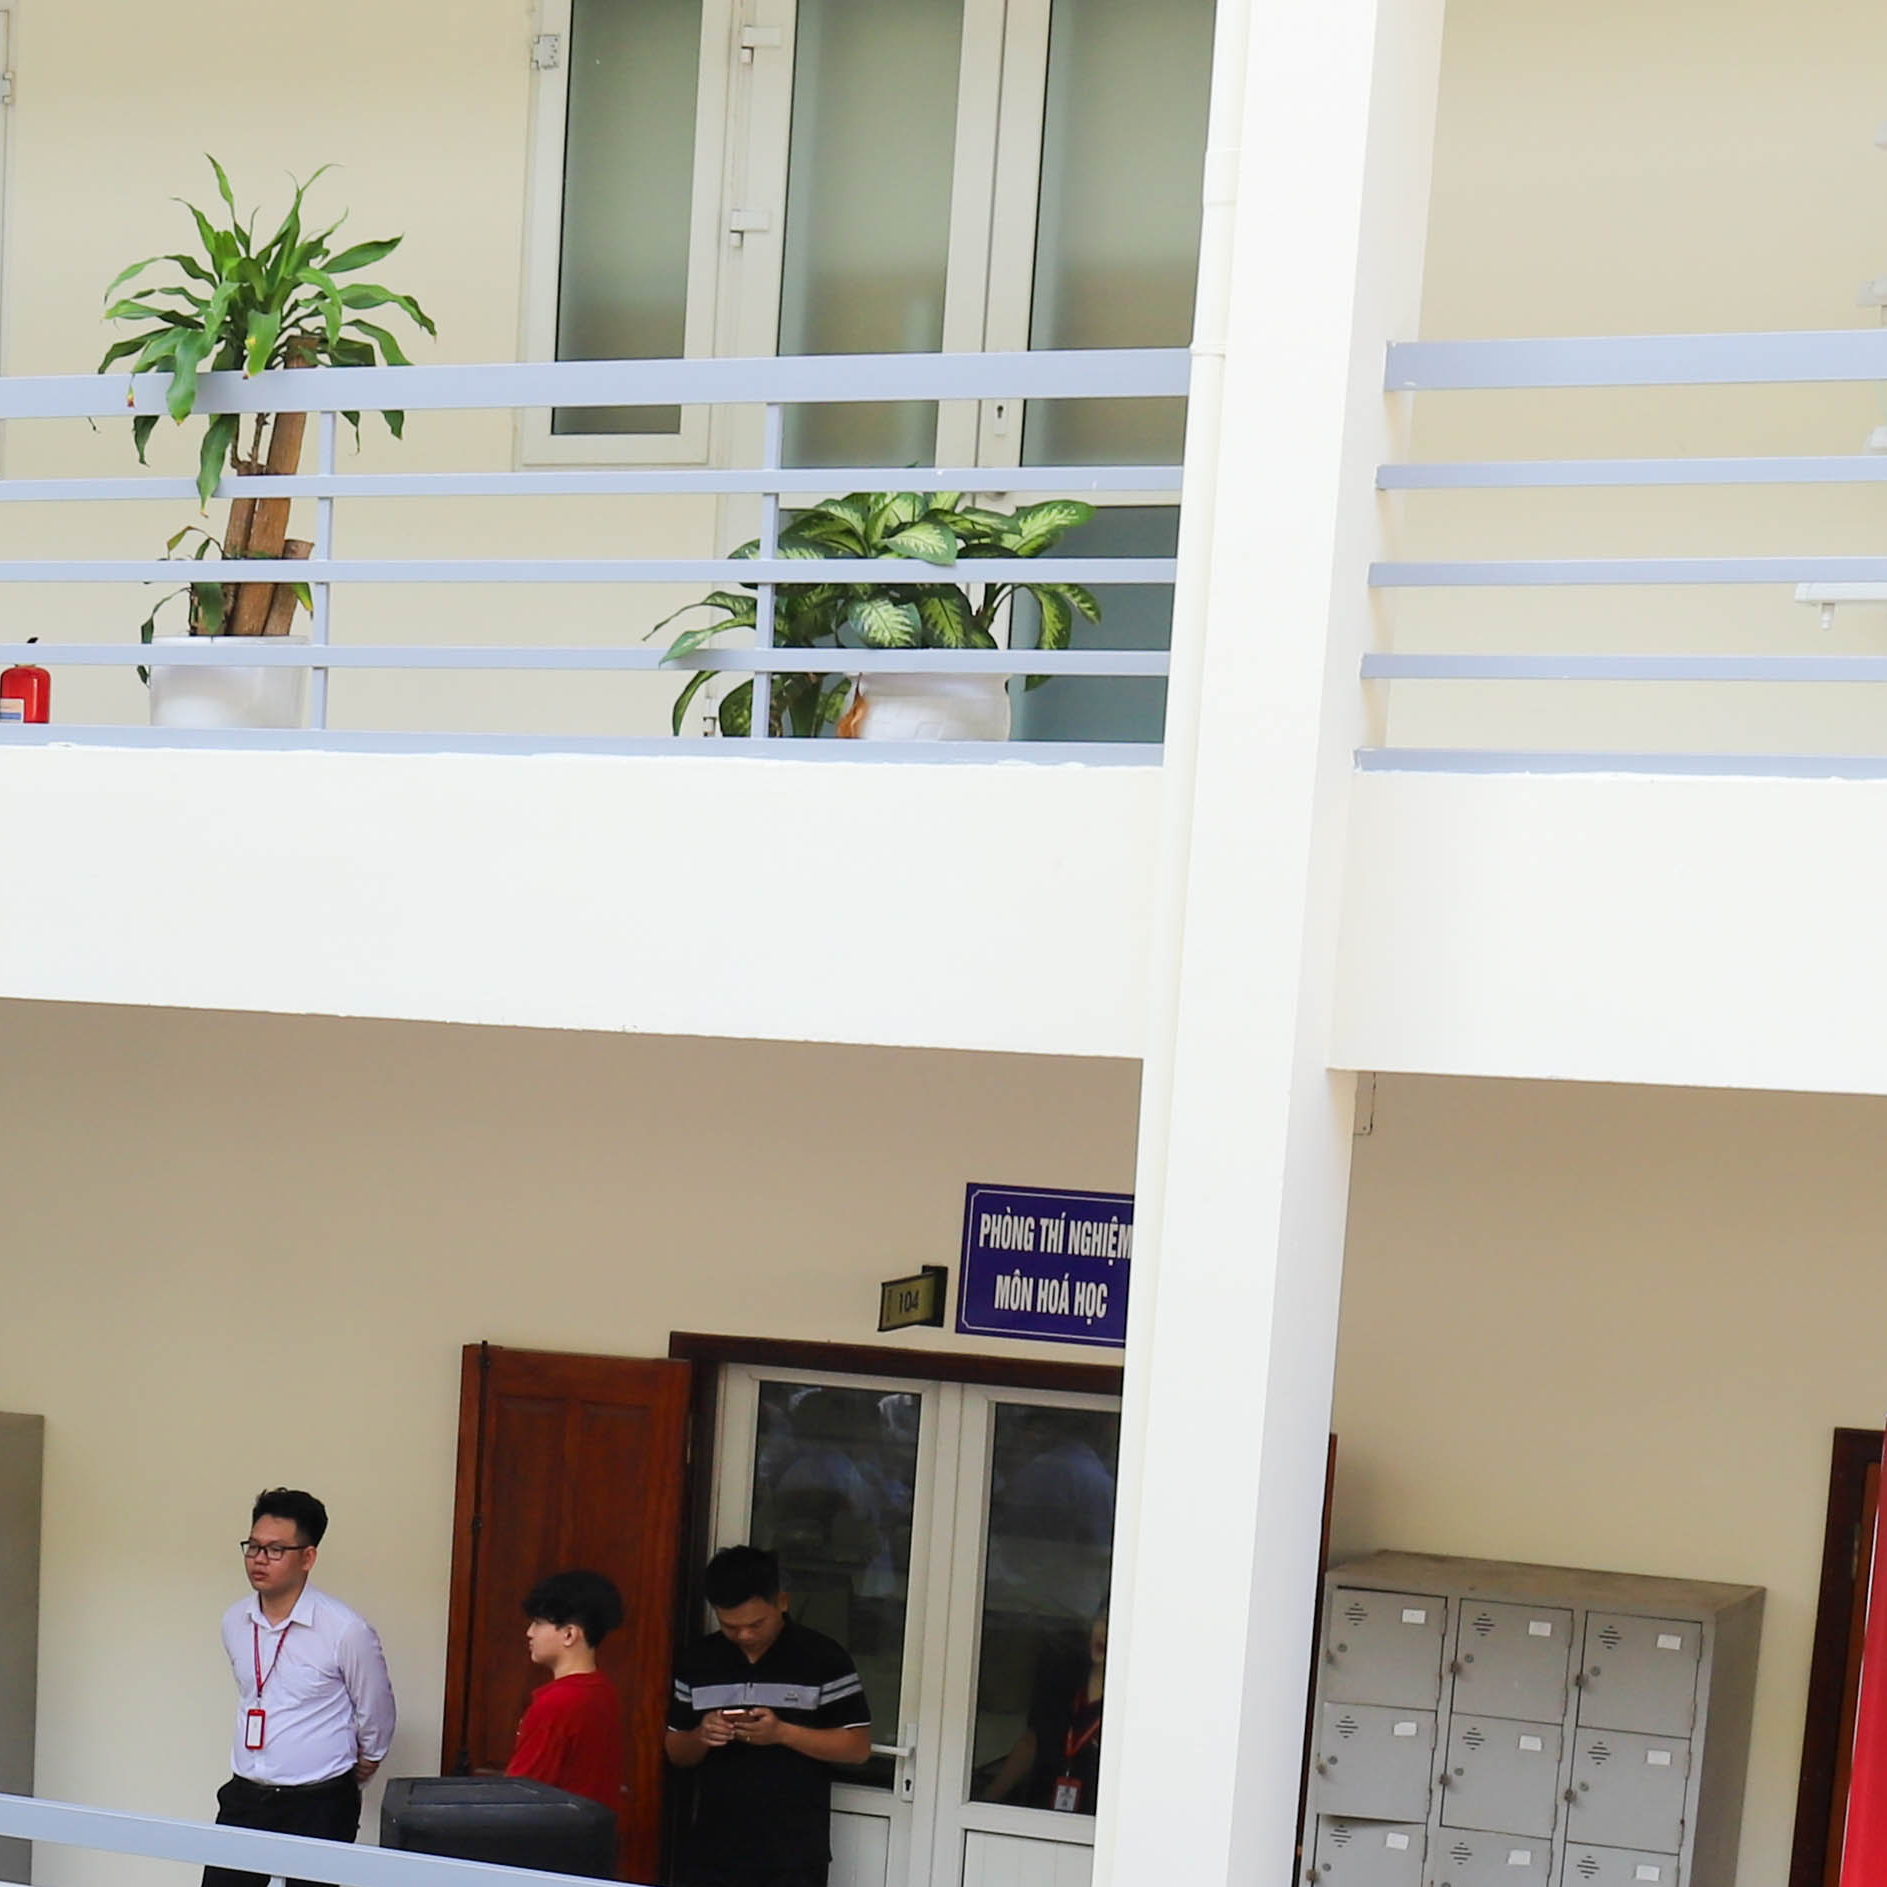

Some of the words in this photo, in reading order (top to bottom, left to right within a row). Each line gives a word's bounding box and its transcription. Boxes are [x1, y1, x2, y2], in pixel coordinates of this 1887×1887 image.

[979, 1206, 1034, 1252] PHÒNG
[1039, 1212, 1066, 1254] THÍ
[1069, 1216, 1133, 1266] NGHIỆM
[898, 1291, 919, 1313] 104
[995, 1269, 1033, 1311] MÔN
[1037, 1272, 1069, 1316] HOÁ
[1074, 1280, 1108, 1325] HỌC
